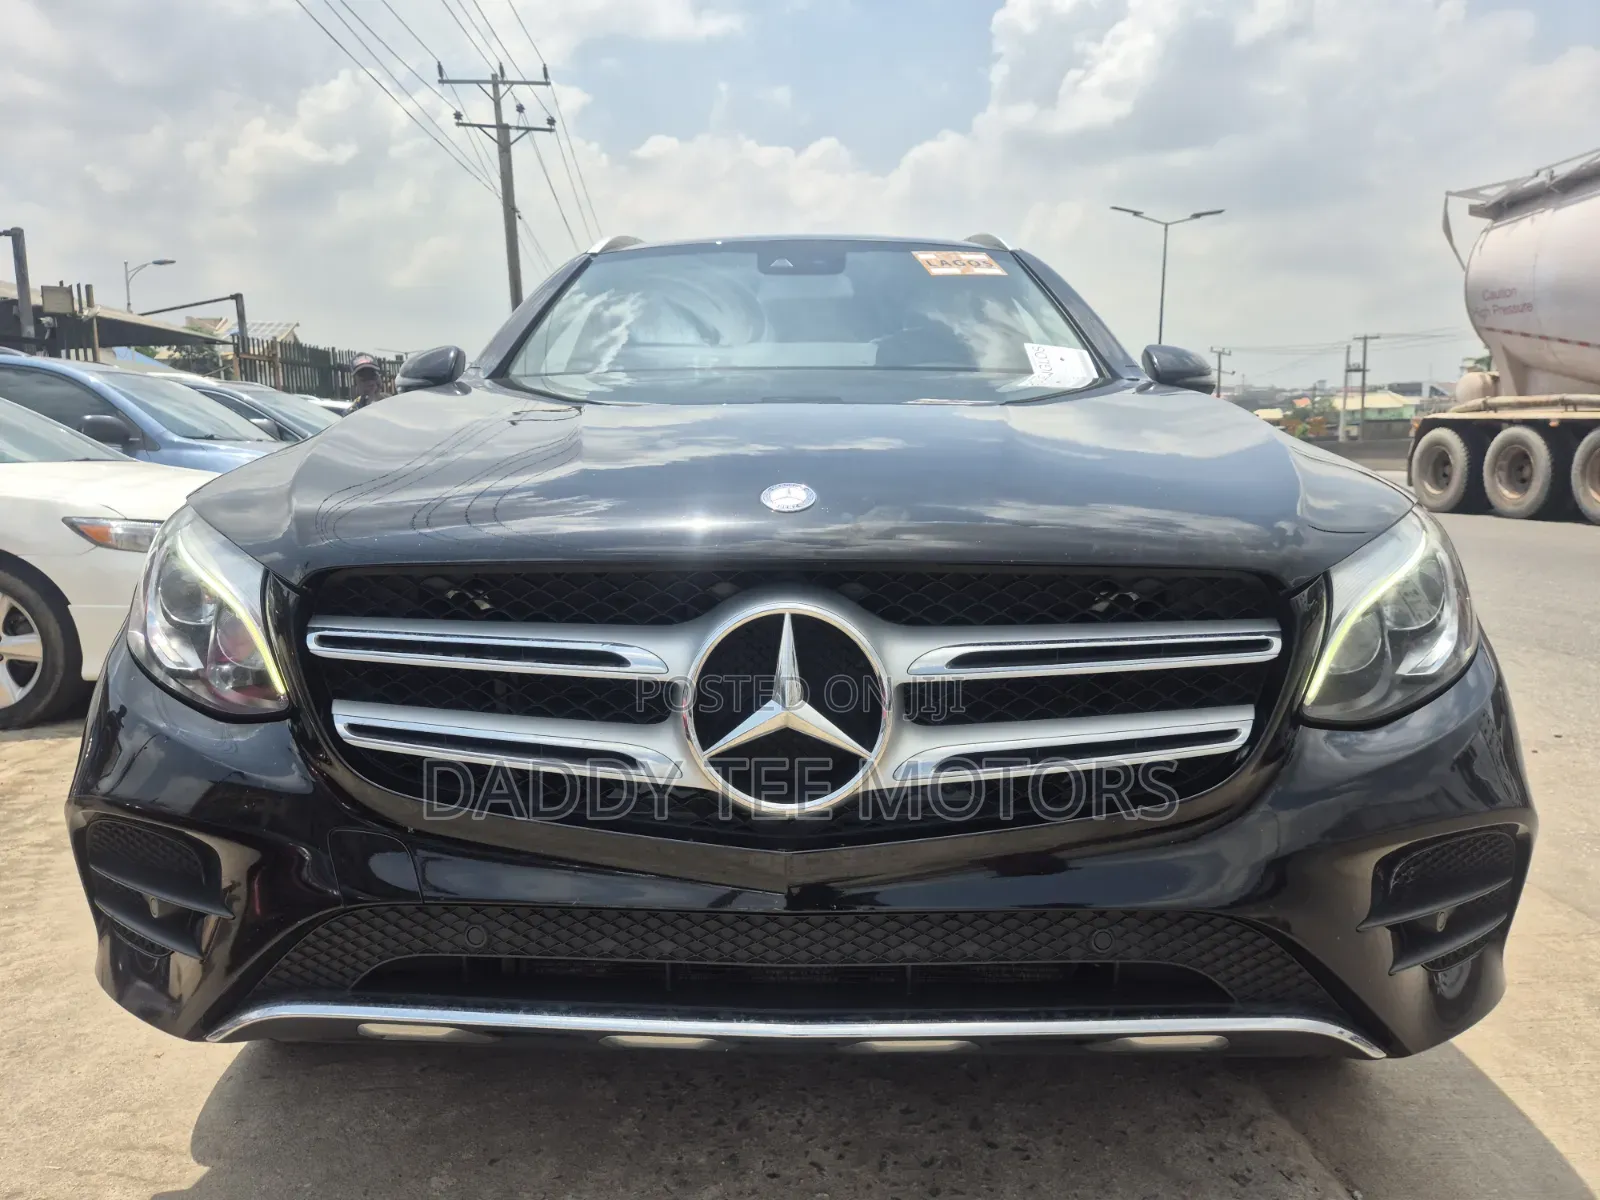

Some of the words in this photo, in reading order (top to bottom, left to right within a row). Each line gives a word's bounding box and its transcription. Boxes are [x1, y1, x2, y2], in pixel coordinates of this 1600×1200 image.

[925, 259, 994, 268] LAGOS
[1483, 288, 1517, 301] Caution
[1492, 302, 1533, 315] Pressure
